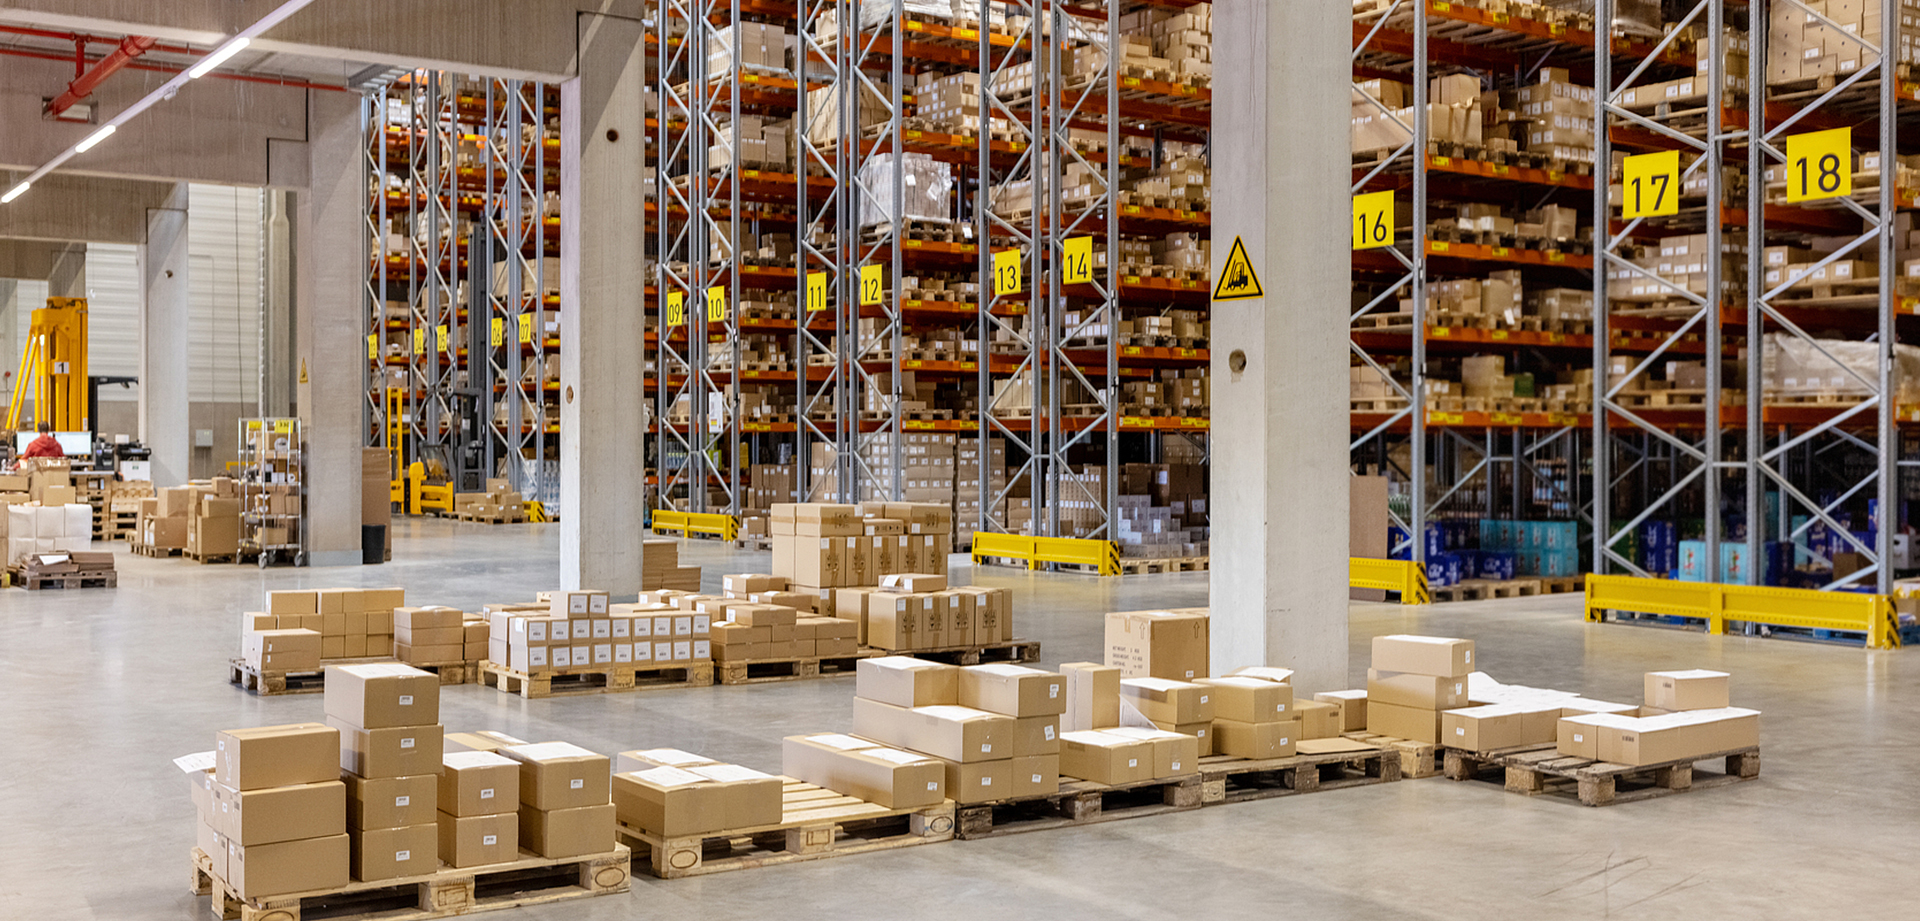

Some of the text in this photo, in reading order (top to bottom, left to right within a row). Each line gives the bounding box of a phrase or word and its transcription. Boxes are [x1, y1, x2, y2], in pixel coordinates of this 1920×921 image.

[1796, 153, 1841, 196] 18
[1631, 174, 1670, 213] 17
[1359, 210, 1387, 244] 16
[1067, 252, 1088, 280] 14
[864, 278, 879, 302] 12
[998, 265, 1017, 292] 13
[809, 285, 822, 308] 11
[669, 303, 680, 323] 09
[710, 298, 722, 319] 10
[492, 328, 501, 344] 06
[520, 323, 530, 341] 07
[59, 362, 64, 373] 1
